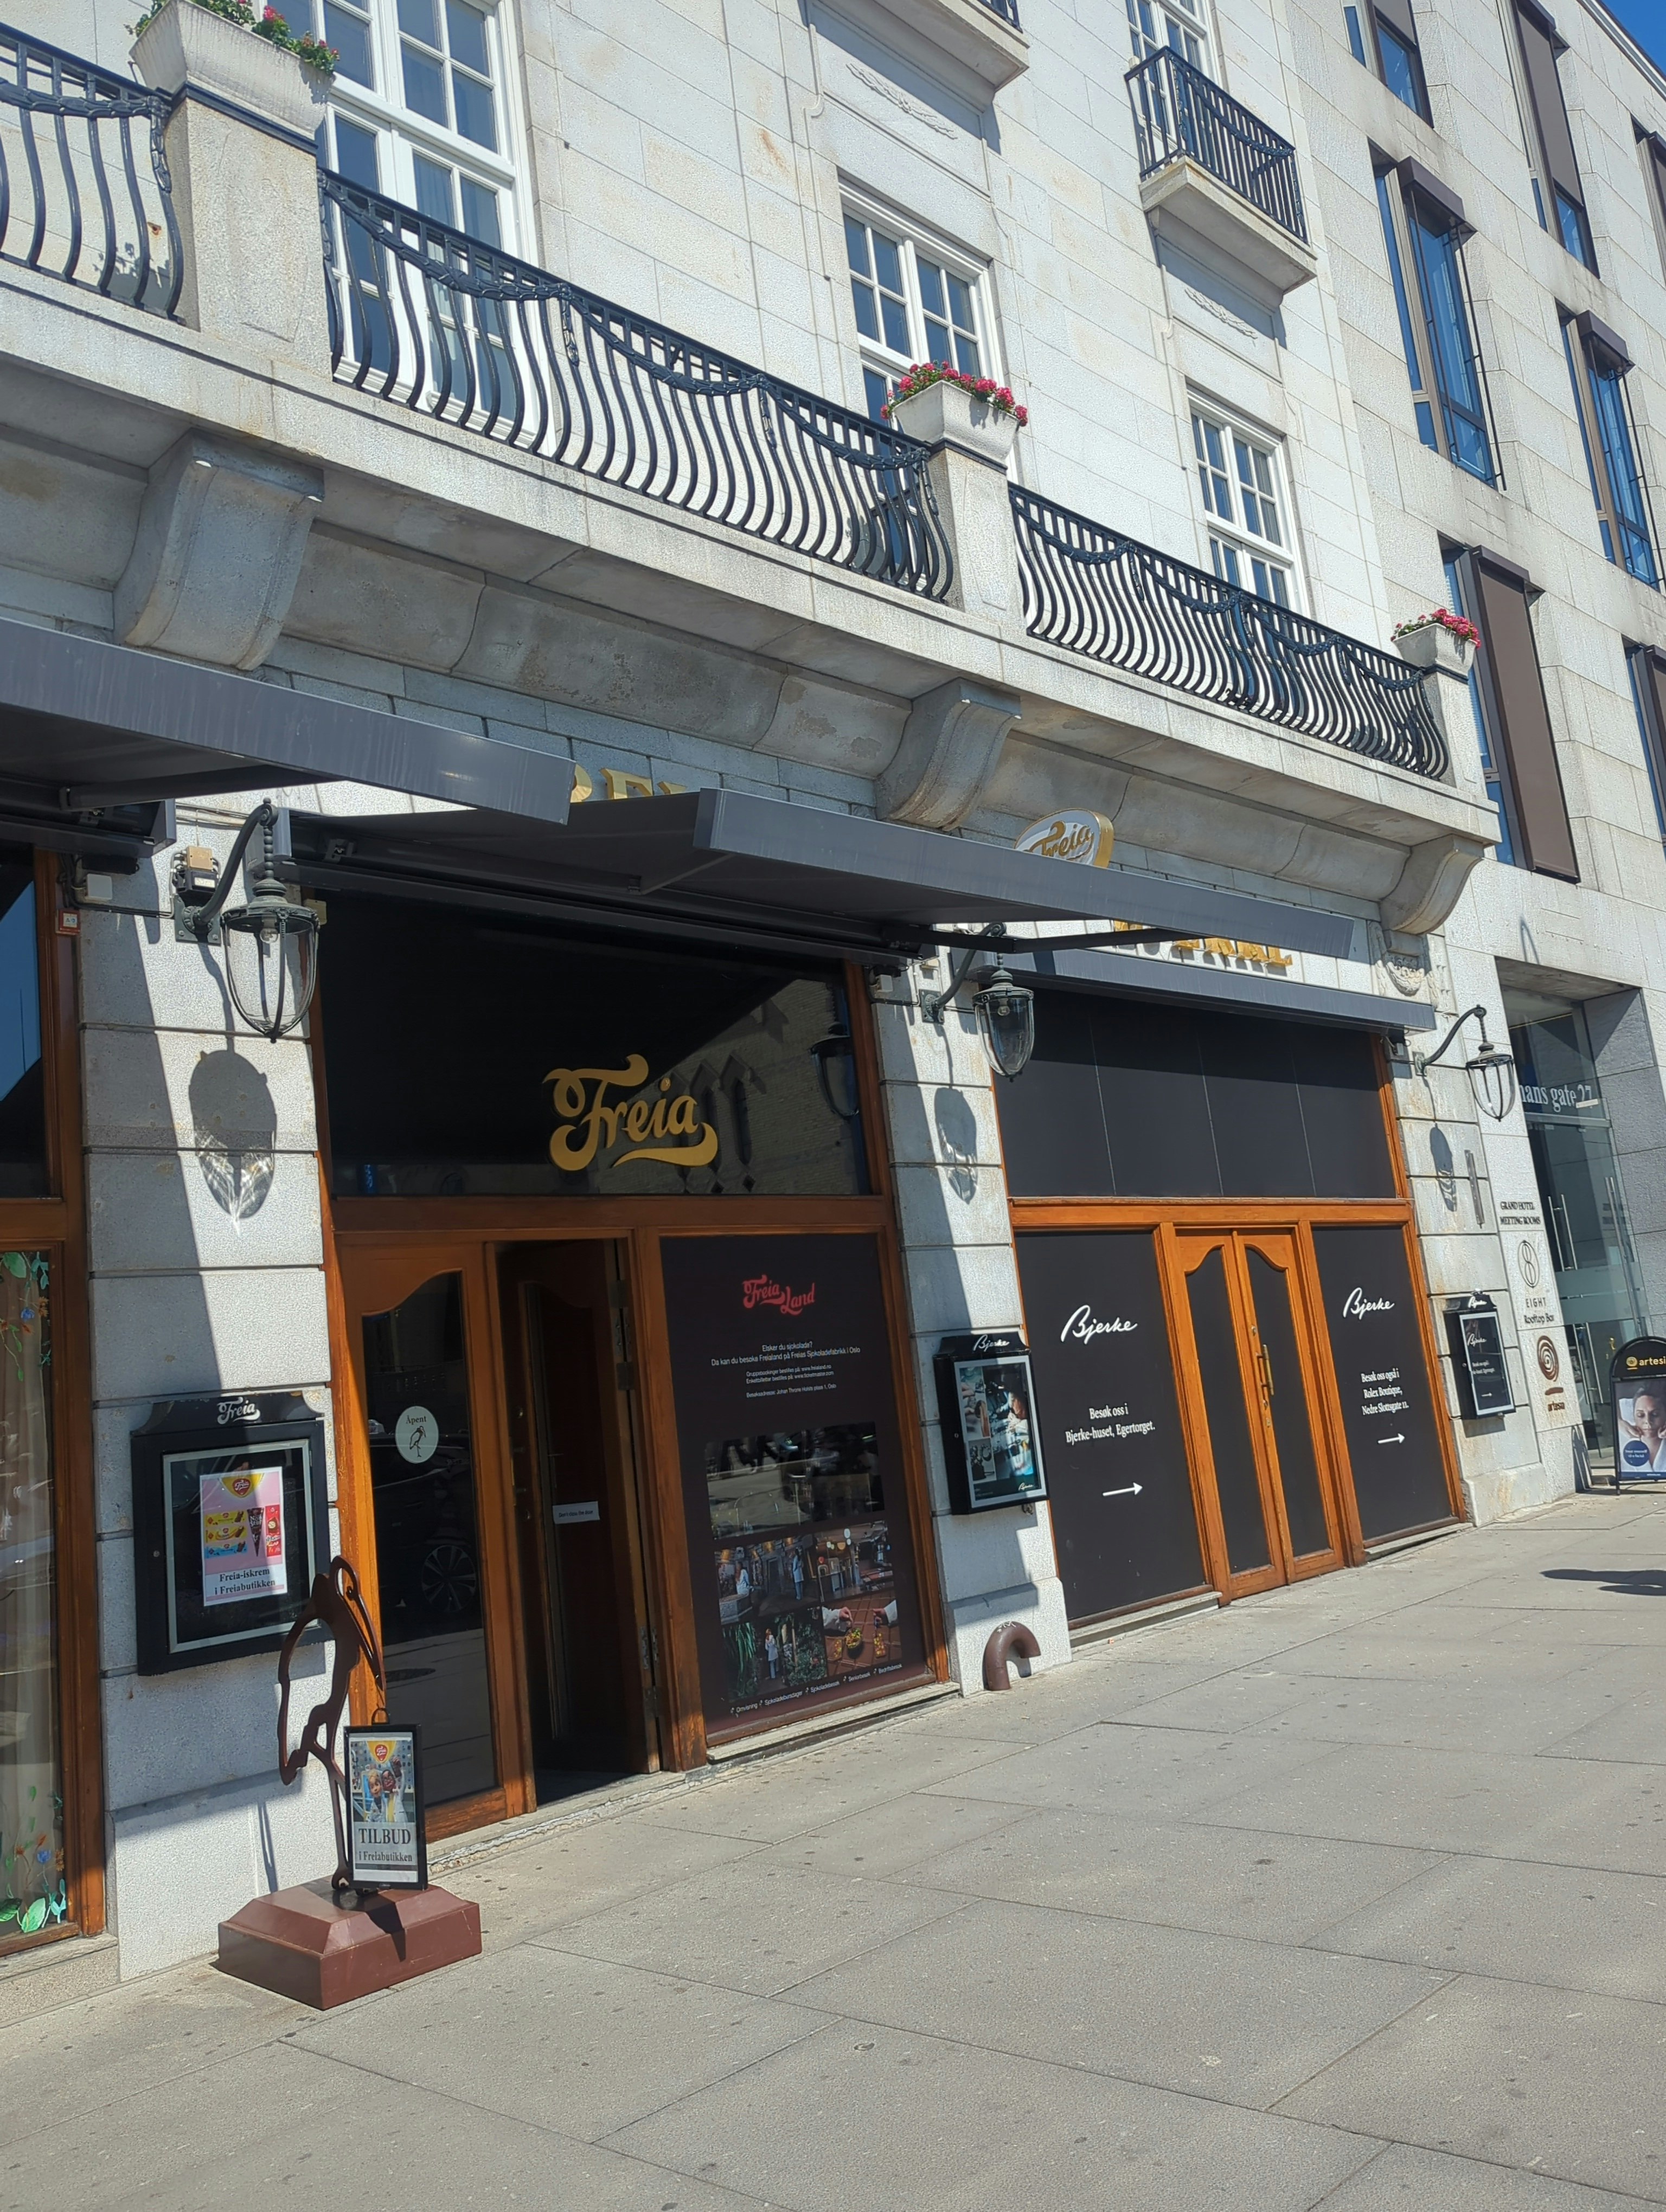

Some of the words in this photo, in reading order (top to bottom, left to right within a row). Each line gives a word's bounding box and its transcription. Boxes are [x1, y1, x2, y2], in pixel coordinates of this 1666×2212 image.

[1550, 1084, 1576, 1112] gate
[1578, 1084, 1592, 1102] 27
[542, 1053, 718, 1171] Freia
[742, 1274, 786, 1308] Freia
[780, 1282, 815, 1315] Land
[1526, 1297, 1546, 1307] EIGHT
[1343, 1288, 1394, 1320] Bjerke
[1061, 1305, 1138, 1345] Bjerke
[1524, 1314, 1545, 1324] Rooftop
[762, 1343, 778, 1352] Elsker
[973, 1334, 1010, 1351] Bjerke
[1363, 1387, 1379, 1398] Rolex
[217, 1397, 260, 1424] Freia
[1089, 1405, 1112, 1419] Besøk
[1112, 1406, 1125, 1416] oss
[1124, 1403, 1129, 1414] i
[1362, 1403, 1378, 1415] Nedre
[406, 1414, 426, 1425] Åpent
[1065, 1425, 1115, 1445] Bjerke-huset,
[1116, 1420, 1155, 1438] Egertorget.
[219, 1568, 270, 1582] Freia-iskrem
[215, 1587, 218, 1596] i
[220, 1580, 275, 1595] Freiabutikken
[358, 1828, 412, 1844] TILBUD
[358, 1851, 362, 1861] i
[363, 1851, 413, 1862] Freiabutikken
